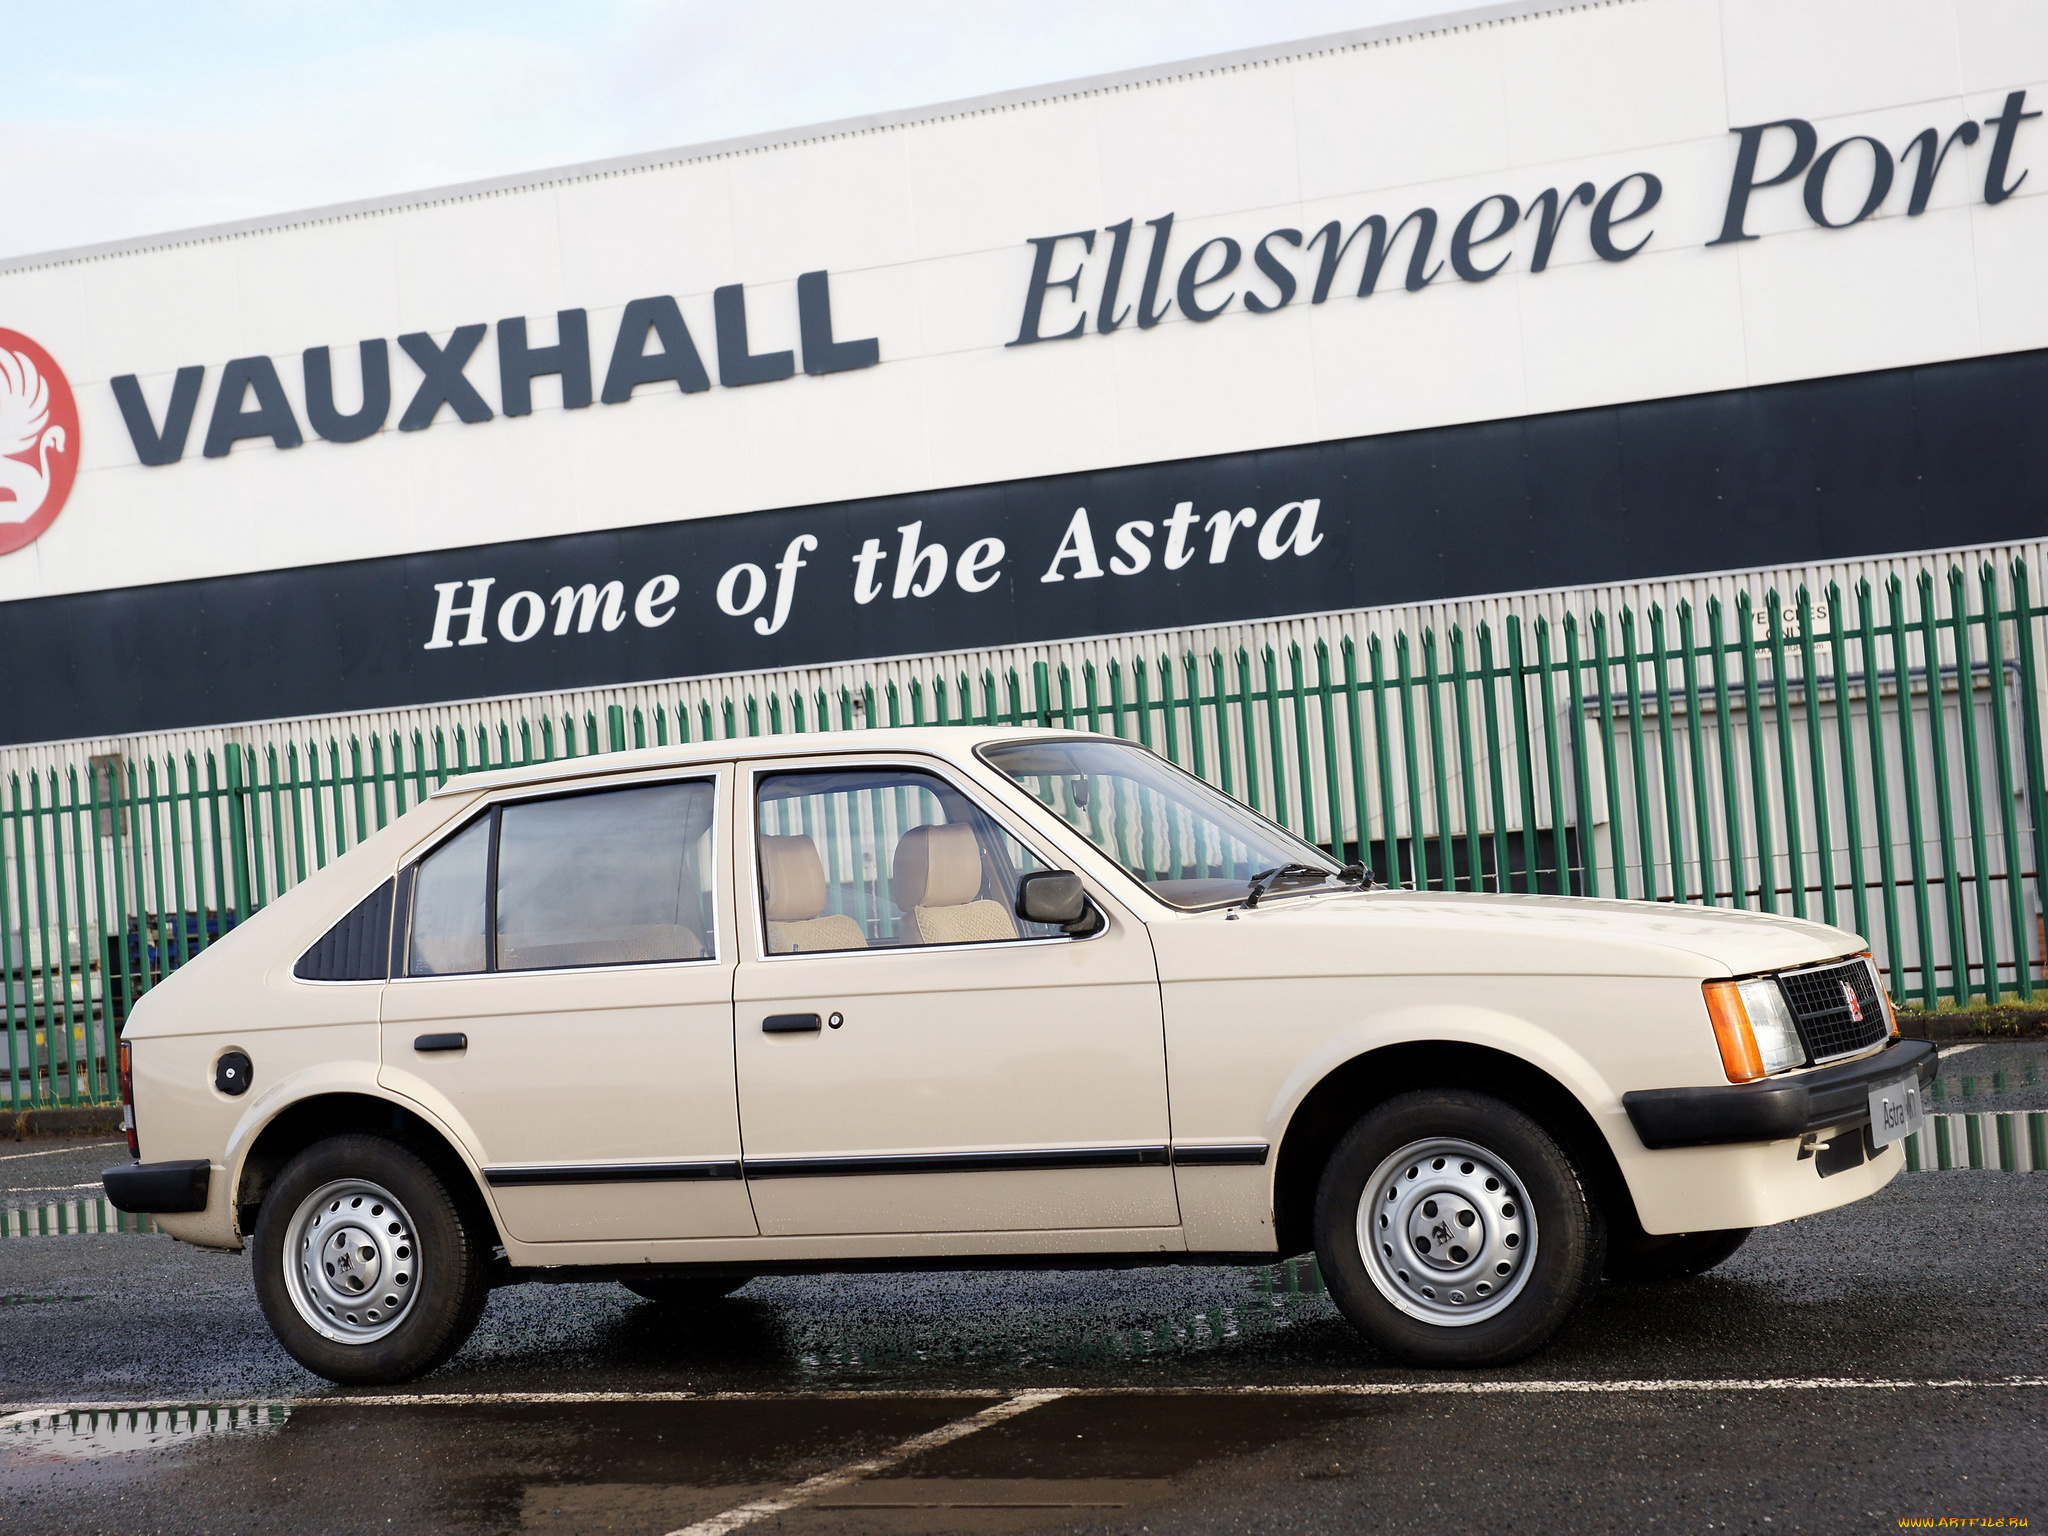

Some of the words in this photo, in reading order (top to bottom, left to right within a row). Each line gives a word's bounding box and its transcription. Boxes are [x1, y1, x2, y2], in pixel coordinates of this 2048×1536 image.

[110, 270, 882, 468] VAUXHALL
[1004, 172, 1663, 348] Ellesmere
[1704, 90, 2044, 248] Port
[423, 574, 680, 650] Home
[716, 533, 819, 636] of
[851, 519, 1006, 605] the
[1040, 498, 1324, 584] Astra
[1750, 605, 1828, 626] ECES
[1765, 625, 1803, 642] NL
[1883, 1101, 1905, 1131] Astra
